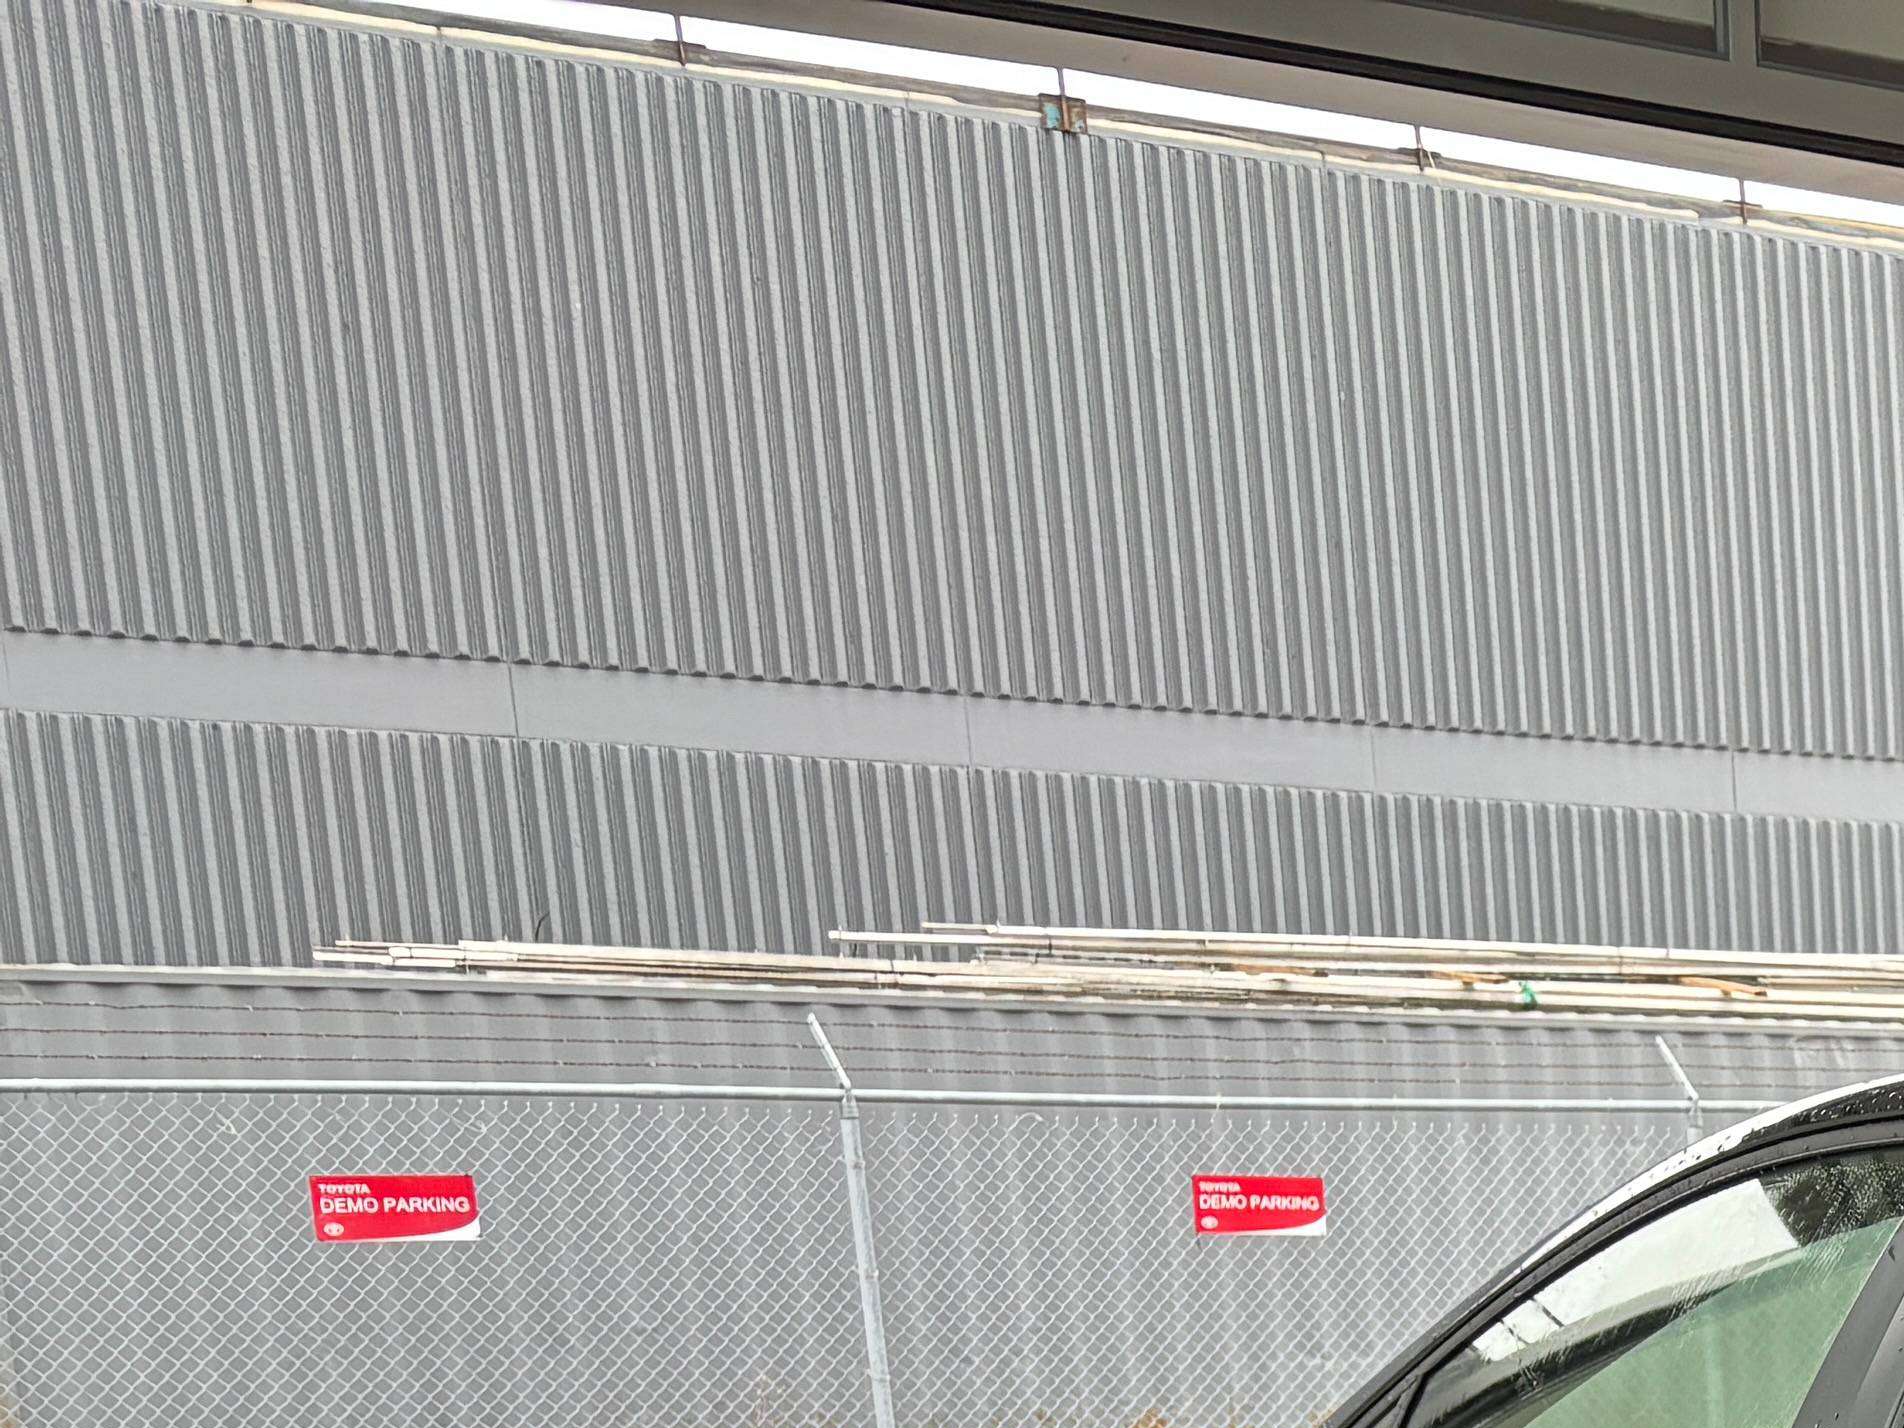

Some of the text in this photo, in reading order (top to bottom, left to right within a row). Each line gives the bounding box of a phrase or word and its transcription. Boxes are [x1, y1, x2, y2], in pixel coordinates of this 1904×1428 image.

[318, 1183, 371, 1195] TOYOTA
[319, 1197, 471, 1214] DEMO PARKING
[1199, 1194, 1320, 1211] DEMO PARKING
